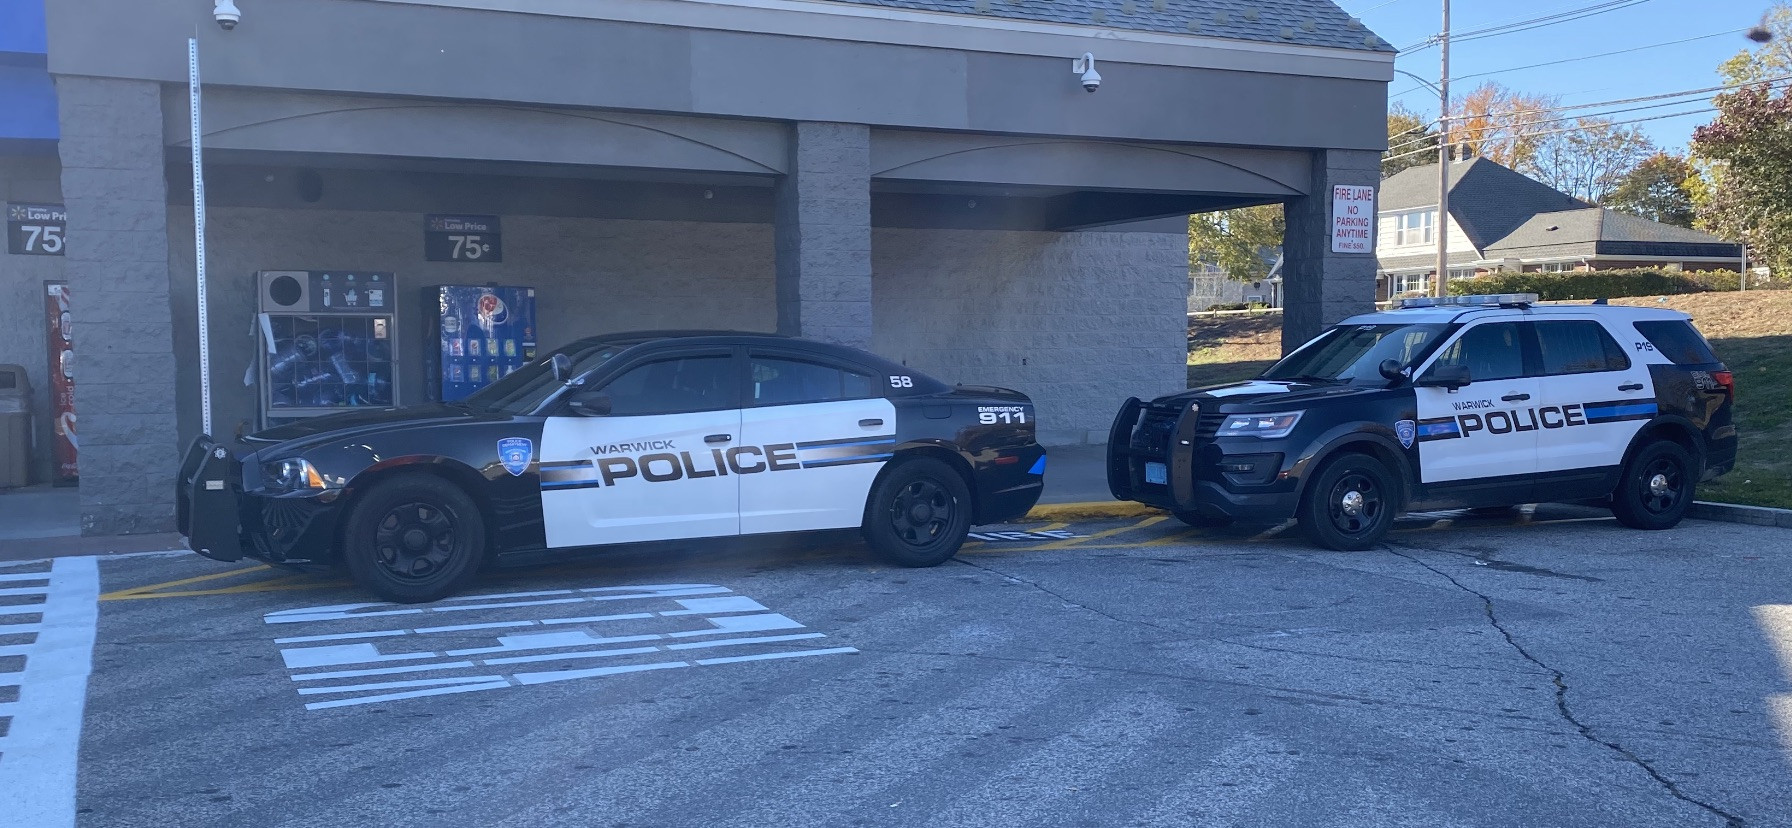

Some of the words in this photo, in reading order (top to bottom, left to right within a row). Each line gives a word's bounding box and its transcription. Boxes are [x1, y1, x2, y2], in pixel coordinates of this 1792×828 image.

[1335, 188, 1351, 201] FIRE
[1353, 189, 1372, 201] LANE
[28, 211, 50, 220] Low
[52, 211, 67, 221] Pri
[1347, 206, 1359, 214] NO
[444, 222, 463, 230] Low
[464, 222, 487, 231] Price
[1336, 216, 1369, 227] PARKING
[1335, 229, 1368, 239] ANYTIME
[889, 375, 914, 388] 58
[977, 406, 1024, 414] EMERGENCY
[1452, 398, 1495, 411] WARWICK
[979, 412, 1026, 425] 911
[1457, 402, 1587, 438] POLICE
[589, 439, 676, 456] WARWICK
[596, 441, 802, 487] POLICE
